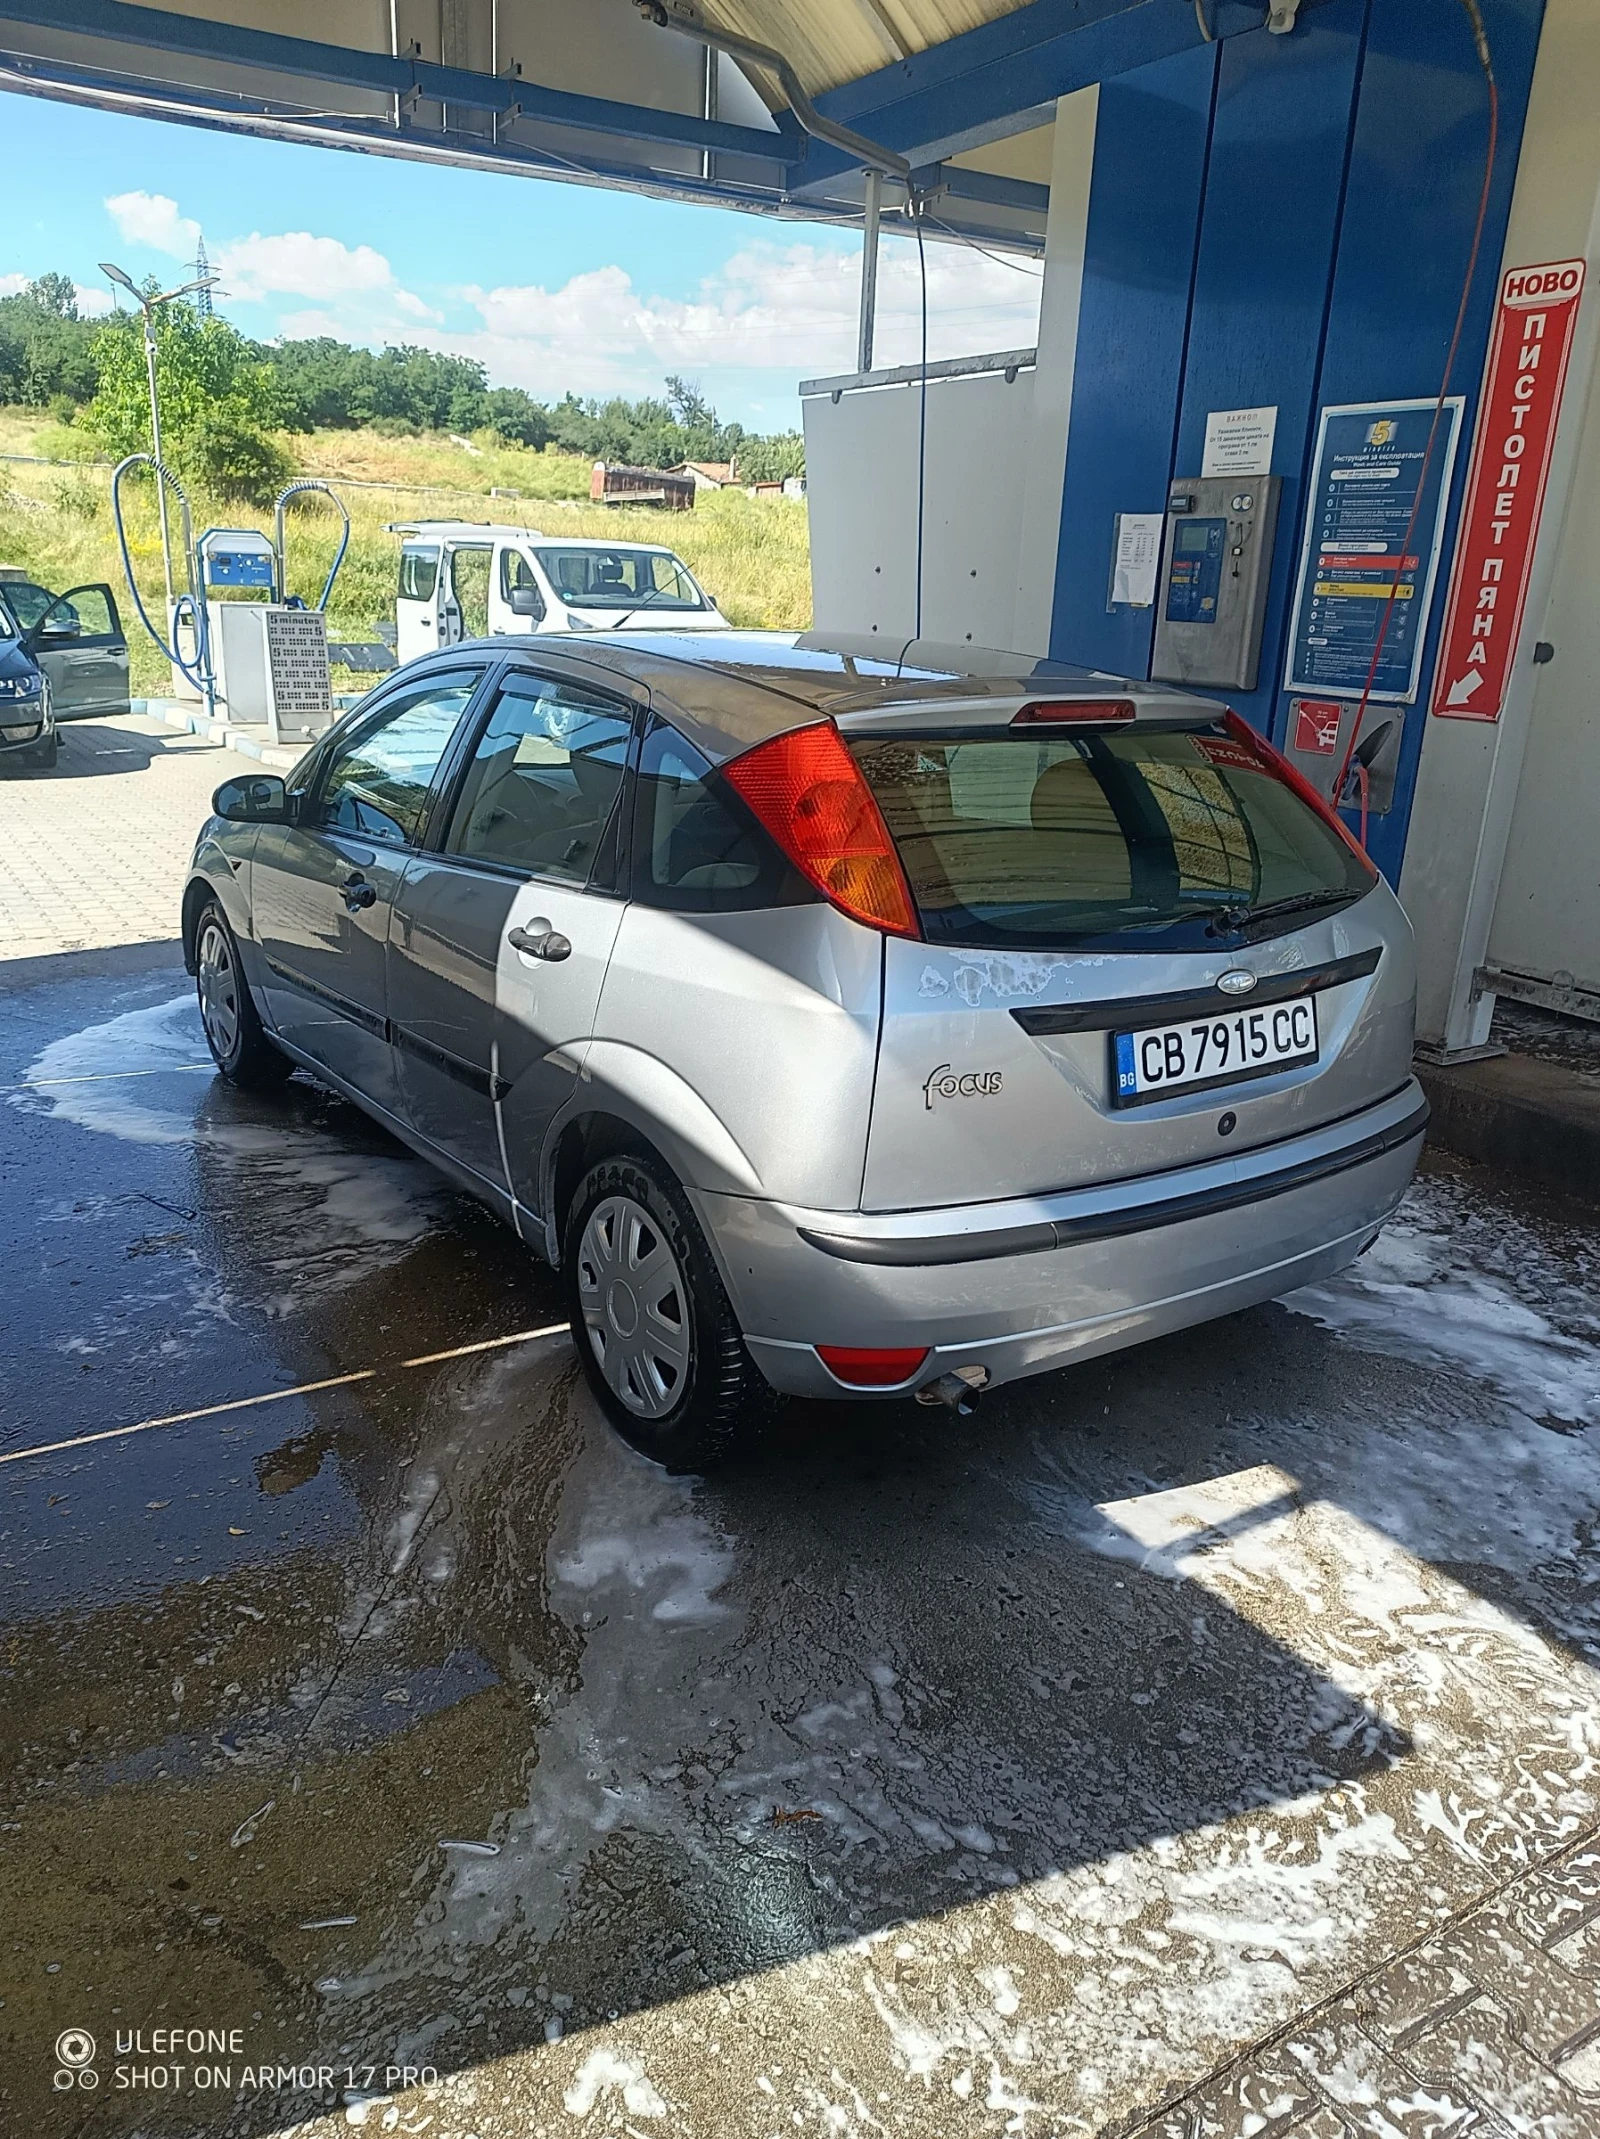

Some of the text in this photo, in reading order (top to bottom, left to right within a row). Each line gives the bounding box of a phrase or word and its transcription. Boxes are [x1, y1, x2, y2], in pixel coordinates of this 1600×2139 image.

[1507, 267, 1578, 298] НОВО
[1371, 420, 1391, 446] 5
[1333, 454, 1369, 463] Инструкция
[1467, 313, 1547, 664] ПИСТОЛЕТ ПЯНА
[270, 614, 320, 625] 5 minutes
[1141, 1005, 1310, 1083] CB 7915 CC
[1119, 1072, 1135, 1088] BG
